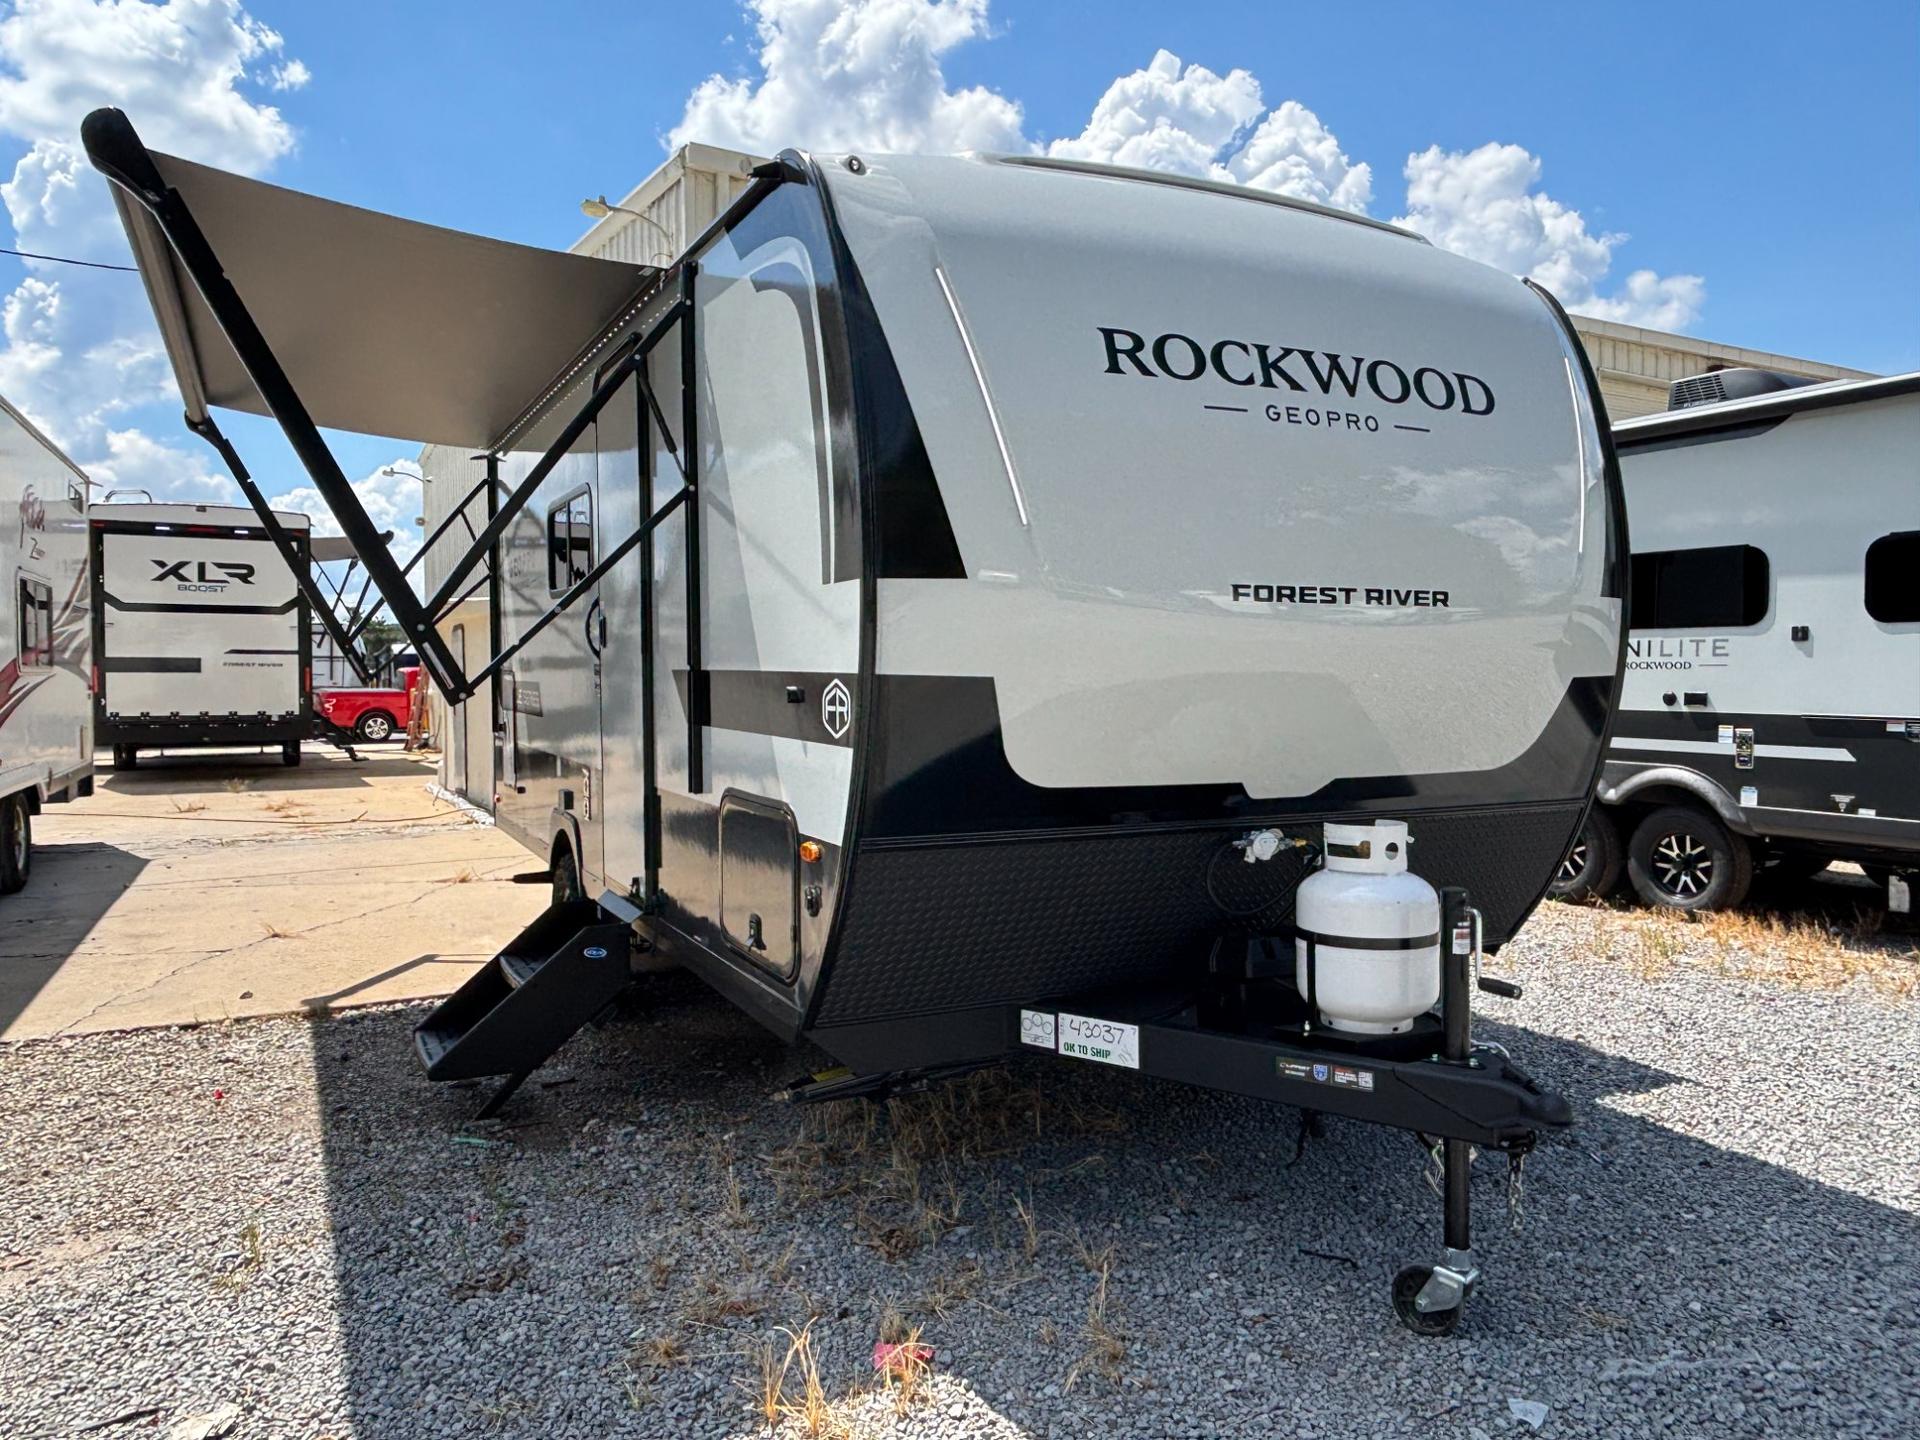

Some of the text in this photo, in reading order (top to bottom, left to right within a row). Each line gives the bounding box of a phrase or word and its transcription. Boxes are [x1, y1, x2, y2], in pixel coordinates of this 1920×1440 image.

[1096, 327, 1496, 416] ROCKWOOD
[1265, 404, 1379, 432] GEOPRO
[150, 559, 256, 585] XLR
[177, 584, 227, 592] BOOST
[1231, 584, 1450, 608] FOREST RIVER
[1069, 1018, 1125, 1044] 43037
[1063, 1041, 1076, 1053] OK
[1077, 1044, 1088, 1055] TO
[1090, 1046, 1111, 1059] SHIP
